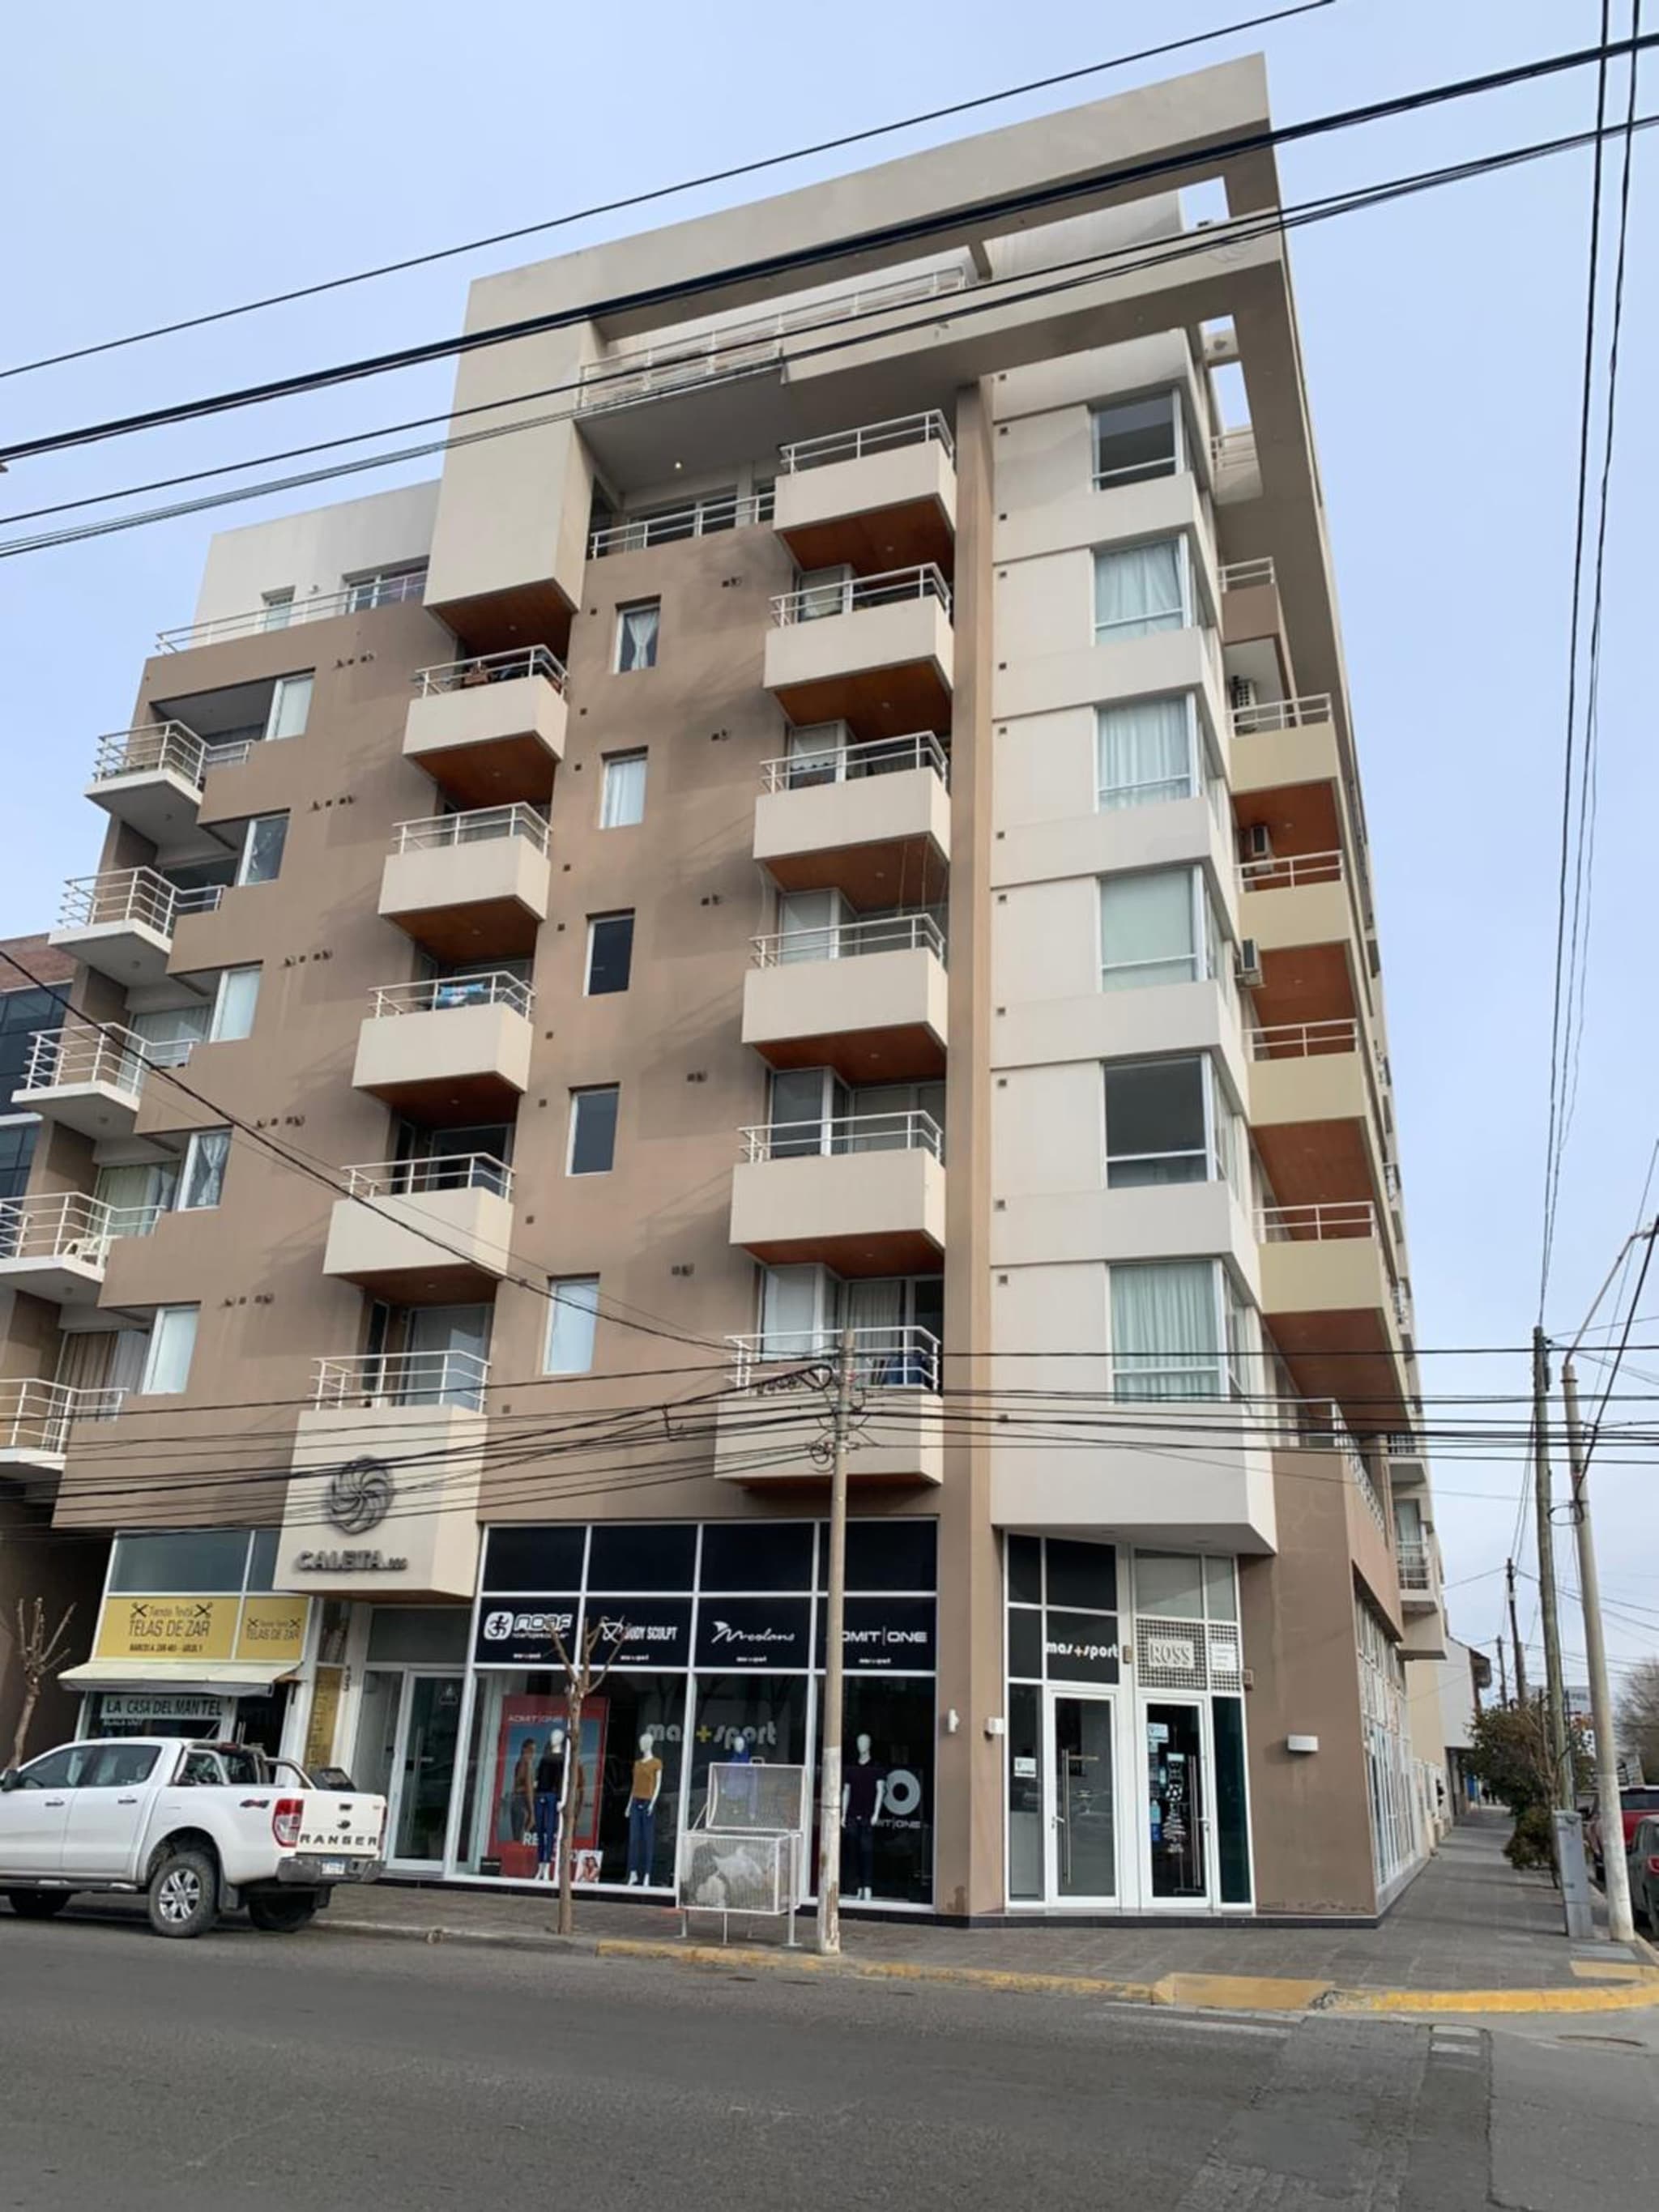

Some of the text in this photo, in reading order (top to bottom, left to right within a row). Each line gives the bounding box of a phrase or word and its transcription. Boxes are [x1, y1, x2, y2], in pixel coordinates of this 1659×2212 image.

[299, 1550, 382, 1571] CALETA
[130, 1619, 211, 1637] TELAS DE ZAR
[646, 1626, 678, 1641] SCULPT
[1149, 1643, 1191, 1665] ROSS
[106, 1698, 223, 1715] LA CASA DEL MANTEL
[299, 1833, 377, 1846] RANGER
